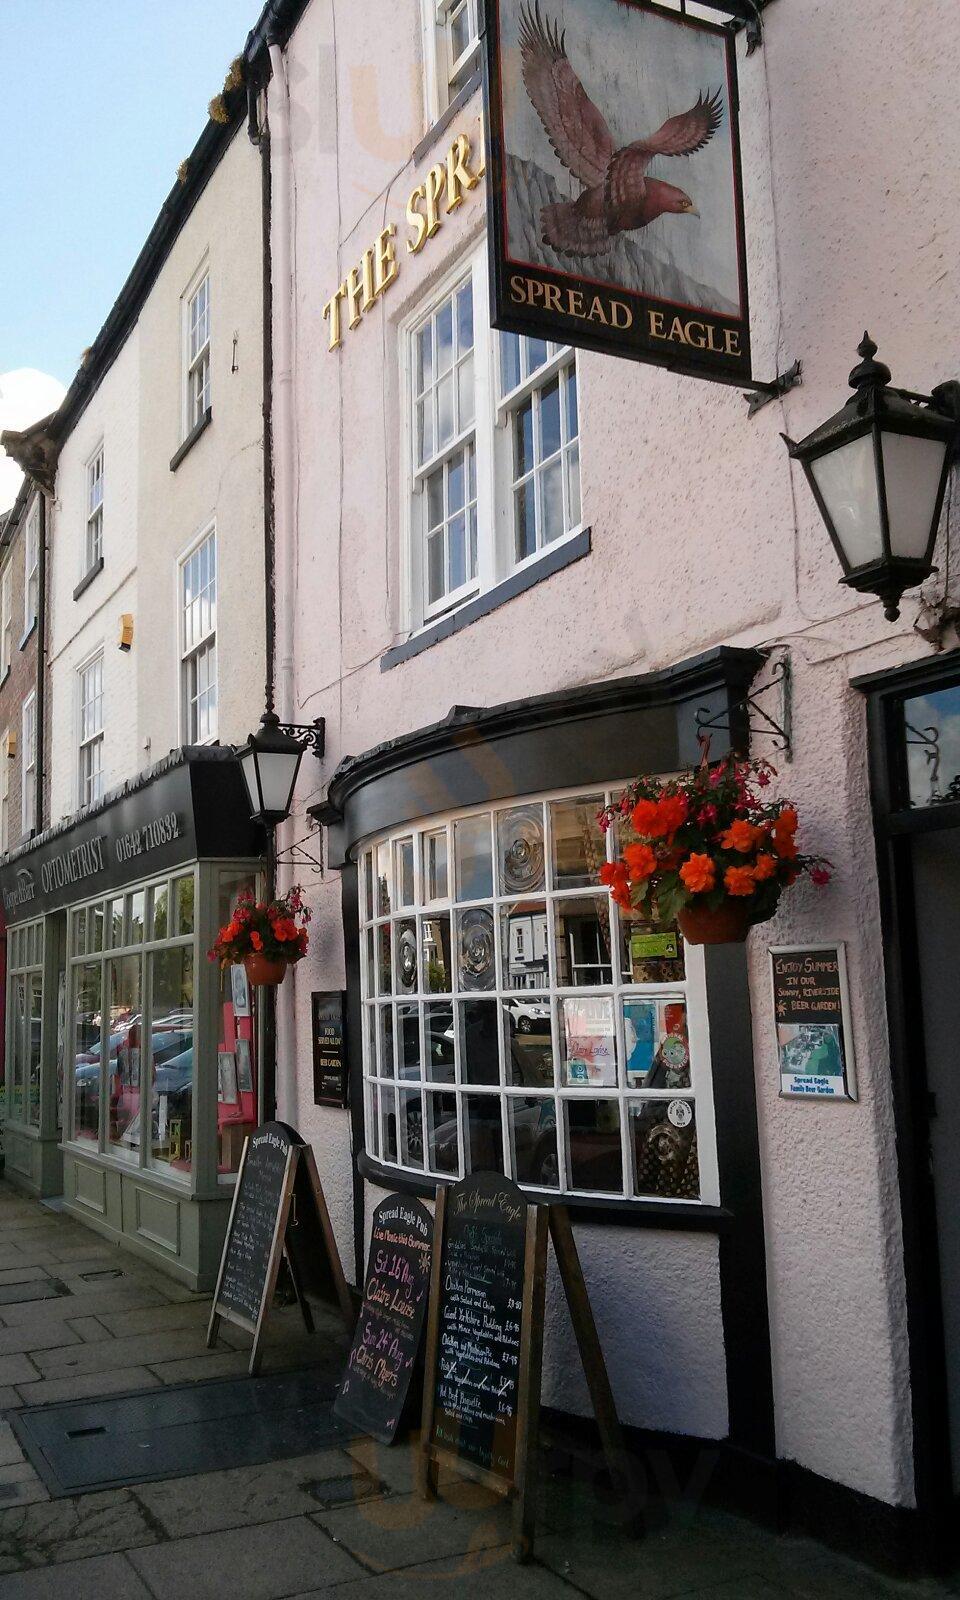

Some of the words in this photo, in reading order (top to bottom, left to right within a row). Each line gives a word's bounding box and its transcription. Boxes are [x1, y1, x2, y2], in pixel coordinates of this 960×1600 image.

[321, 223, 400, 353] THE
[509, 275, 634, 330] SPREAD
[648, 310, 742, 357] EAGLE
[41, 836, 105, 894] OPTOMETRIST
[115, 831, 143, 863] 01642
[800, 977, 816, 986] OUR
[790, 1000, 810, 1011] BEER
[378, 1206, 399, 1225] Spread
[399, 1206, 416, 1226] Eagle
[415, 1215, 429, 1237] Pub
[498, 1191, 521, 1224] Eagle
